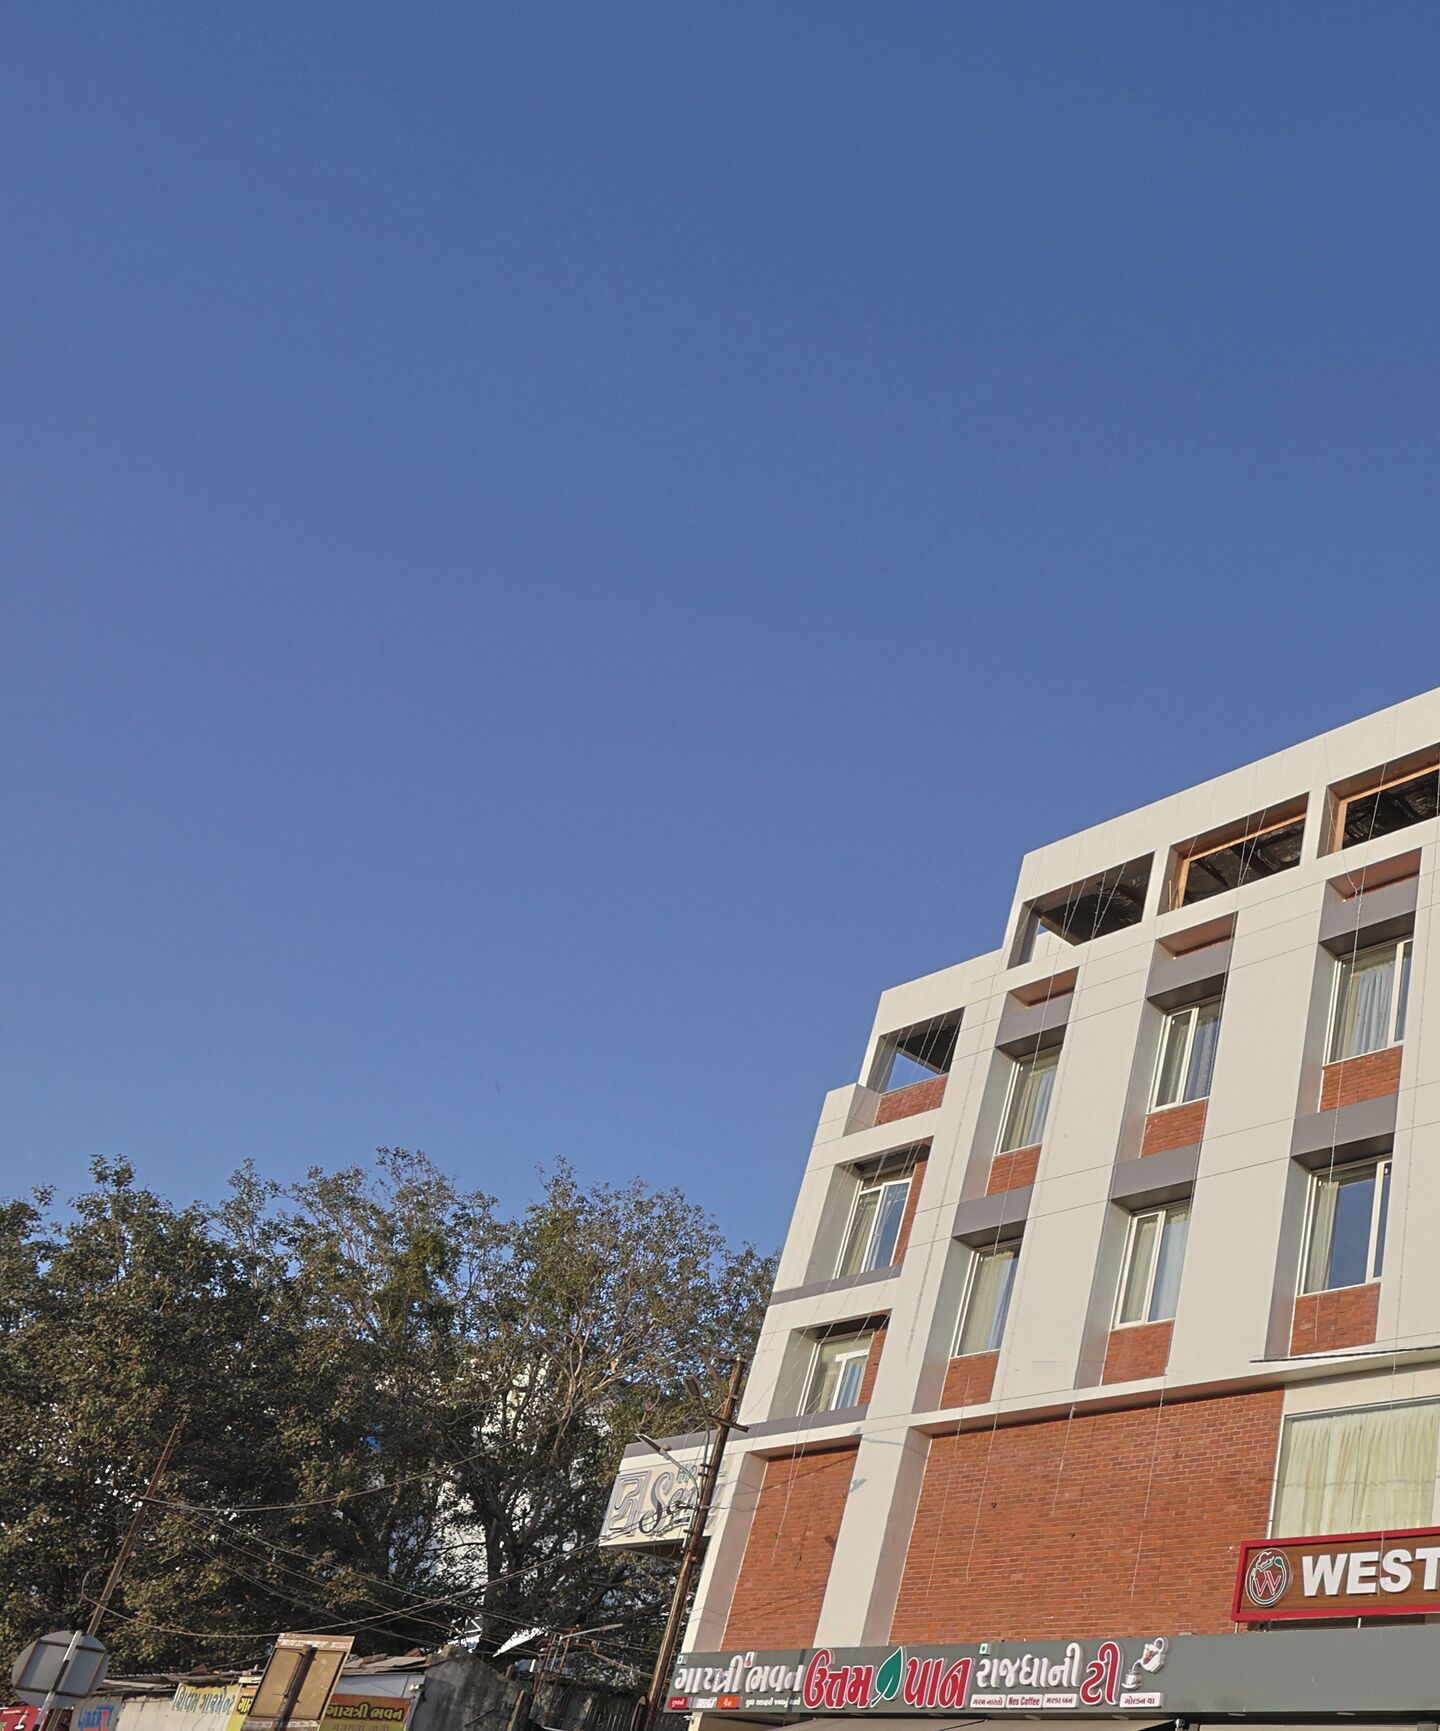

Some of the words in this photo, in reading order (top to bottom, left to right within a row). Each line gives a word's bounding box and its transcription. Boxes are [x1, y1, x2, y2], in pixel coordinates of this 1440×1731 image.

[674, 1655, 744, 1693] ગાયત્રી
[745, 1664, 804, 1693] ભવન
[803, 1649, 874, 1709] ઉત્તમ
[903, 1656, 973, 1709] પાન
[976, 1642, 1081, 1688] રાજધાની
[1080, 1641, 1121, 1706] ટી
[326, 1703, 369, 1719] ગાયત્રી
[370, 1706, 404, 1720] ભવન
[1008, 1697, 1019, 1706] Nes
[1020, 1697, 1040, 1706] Coffee
